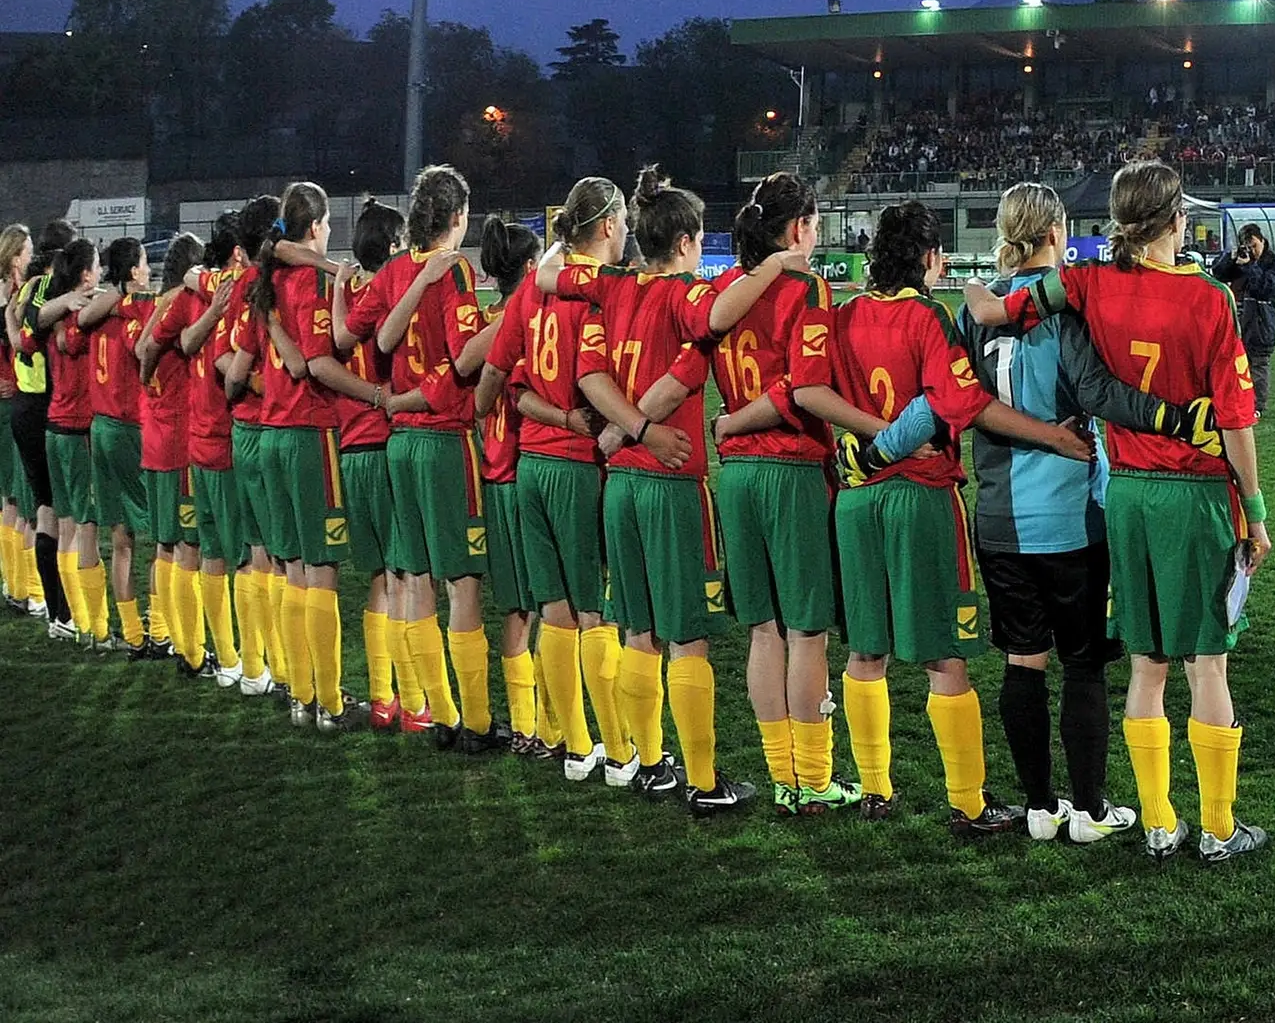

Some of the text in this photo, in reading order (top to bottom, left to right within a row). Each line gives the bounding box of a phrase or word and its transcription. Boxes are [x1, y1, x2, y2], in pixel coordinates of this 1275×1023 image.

[97, 334, 108, 383] 9
[528, 308, 559, 382] 18
[612, 340, 642, 406] 17
[719, 329, 762, 401] 16
[984, 336, 1015, 408] 1
[1130, 341, 1161, 394] 7
